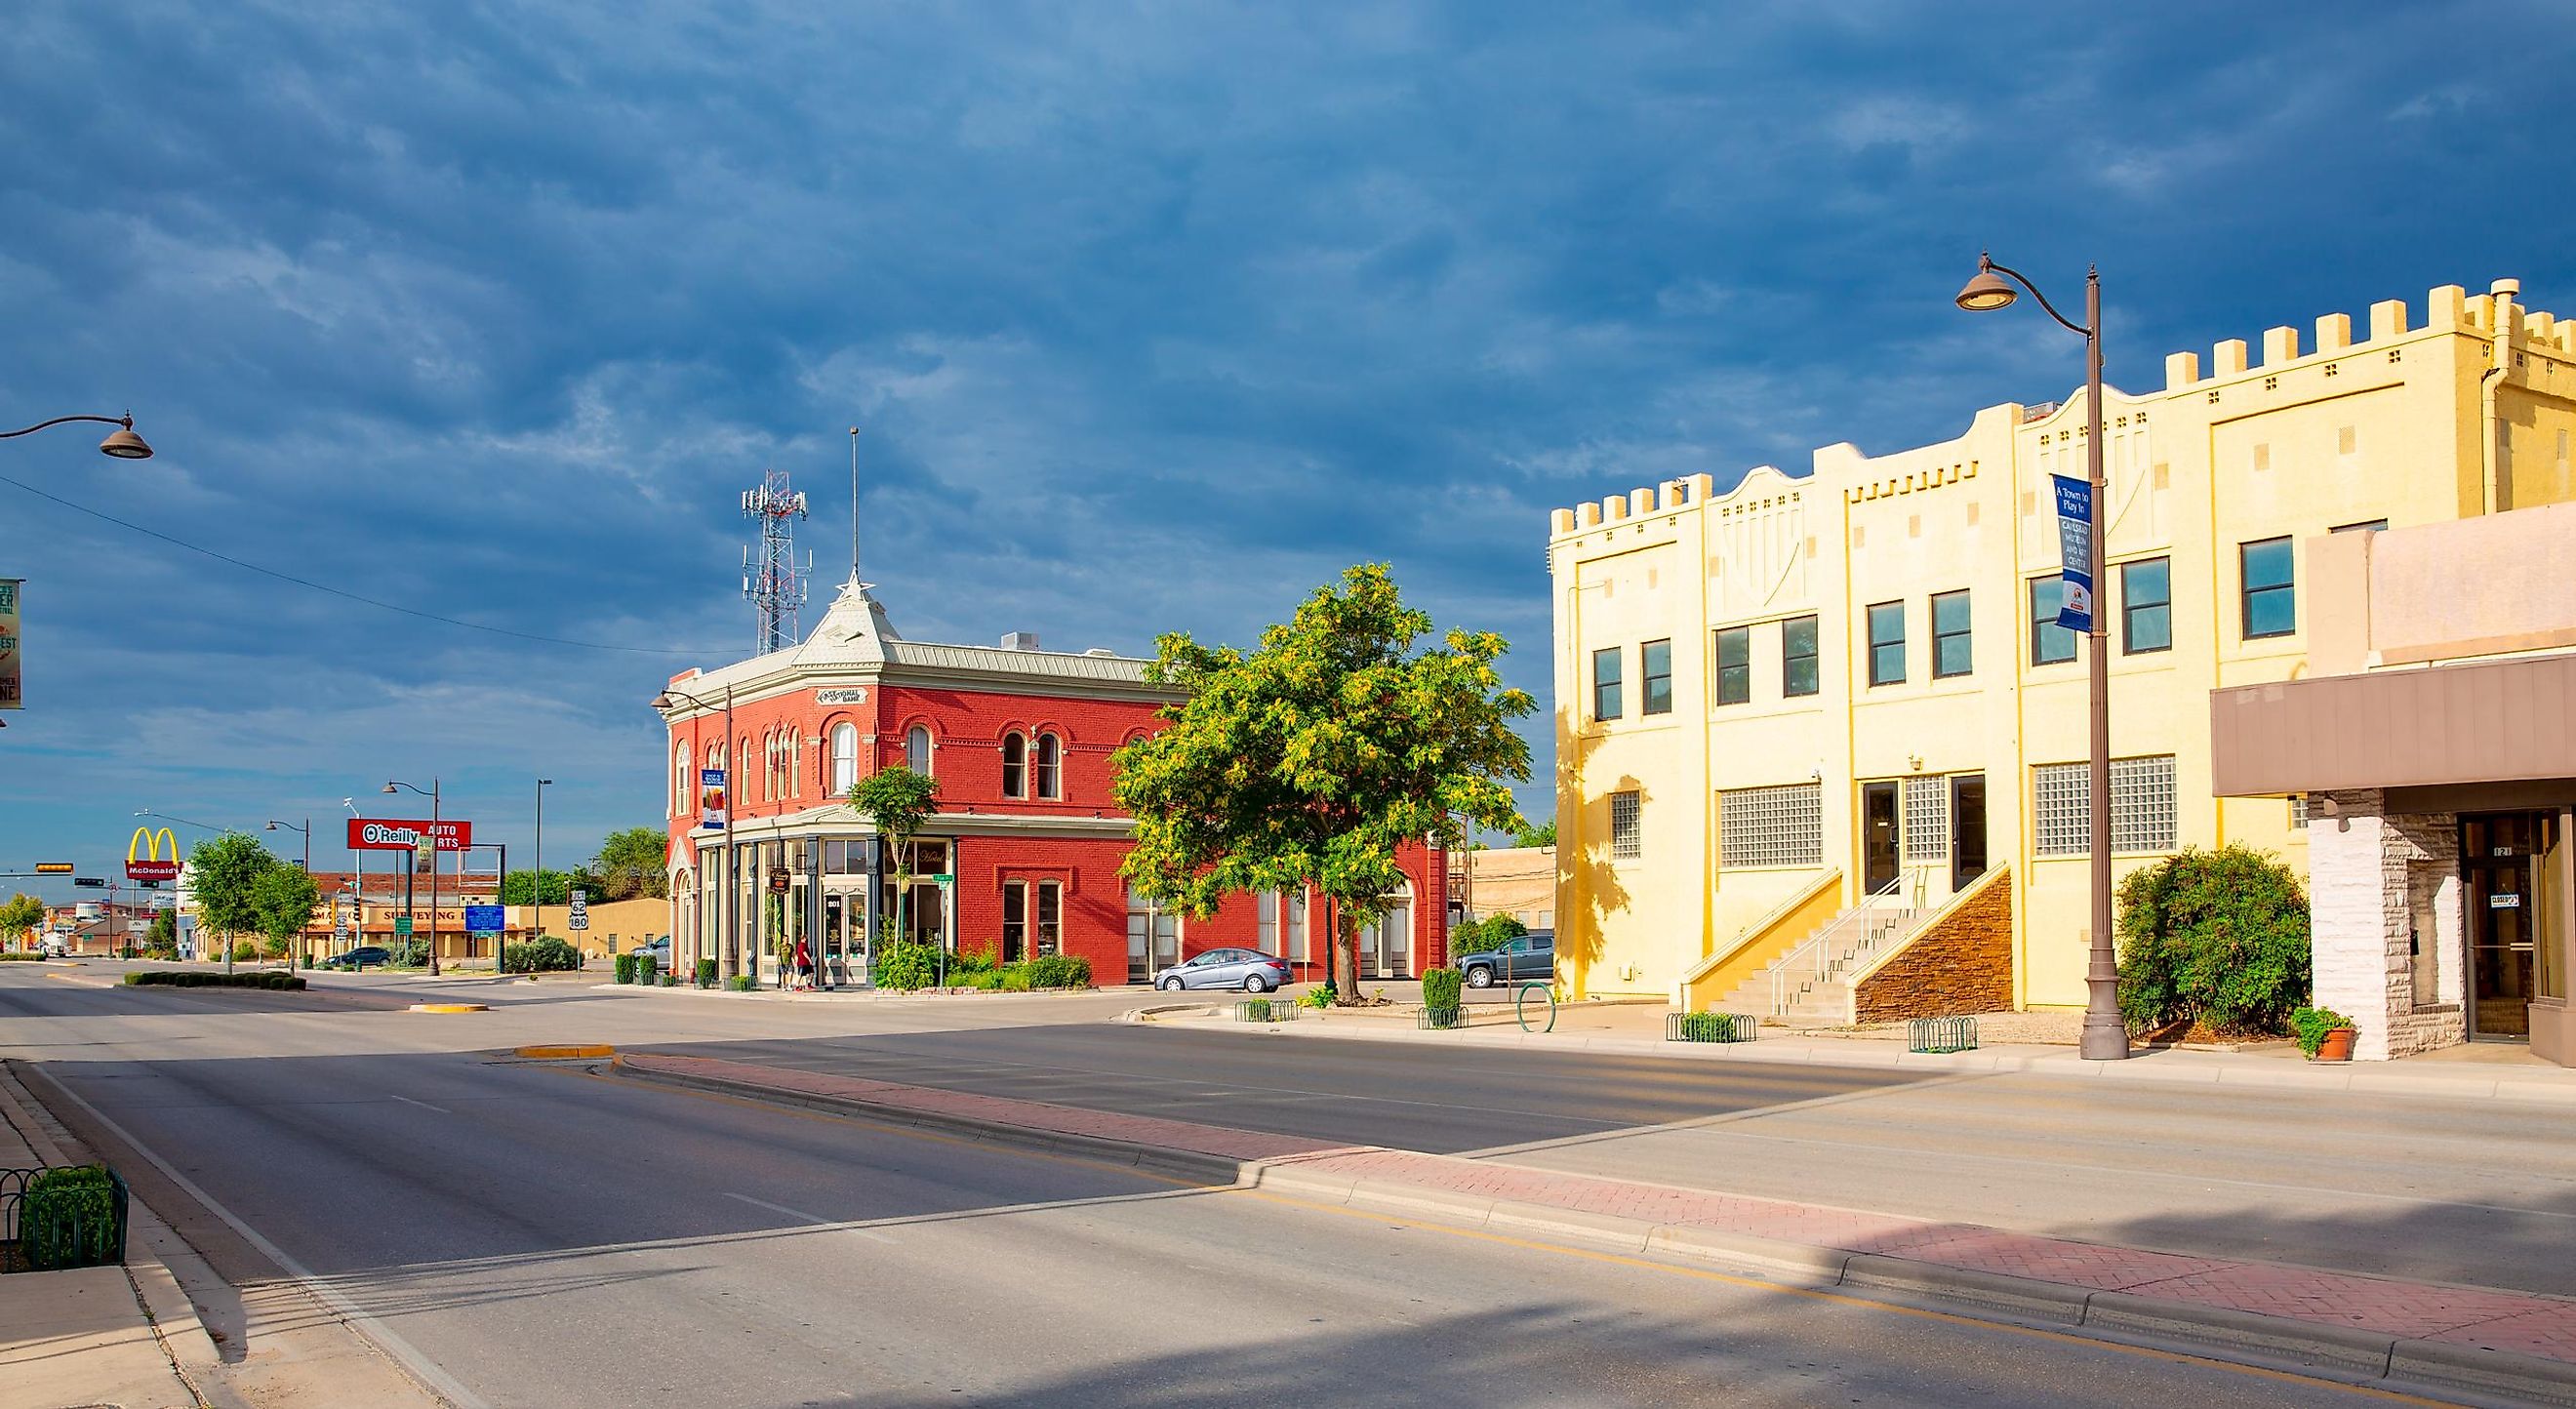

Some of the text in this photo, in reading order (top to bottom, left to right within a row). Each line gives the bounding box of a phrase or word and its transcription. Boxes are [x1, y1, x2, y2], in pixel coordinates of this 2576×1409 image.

[2056, 487, 2089, 503] A Town to
[2063, 500, 2085, 515] Play In
[2066, 545, 2078, 555] AND
[364, 825, 419, 845] O'Reilly
[427, 825, 457, 836] AUTO
[438, 837, 459, 848] RTS
[2494, 847, 2512, 857] 121
[129, 866, 180, 875] McDonald's
[573, 903, 584, 912] 62
[571, 918, 587, 927] 180
